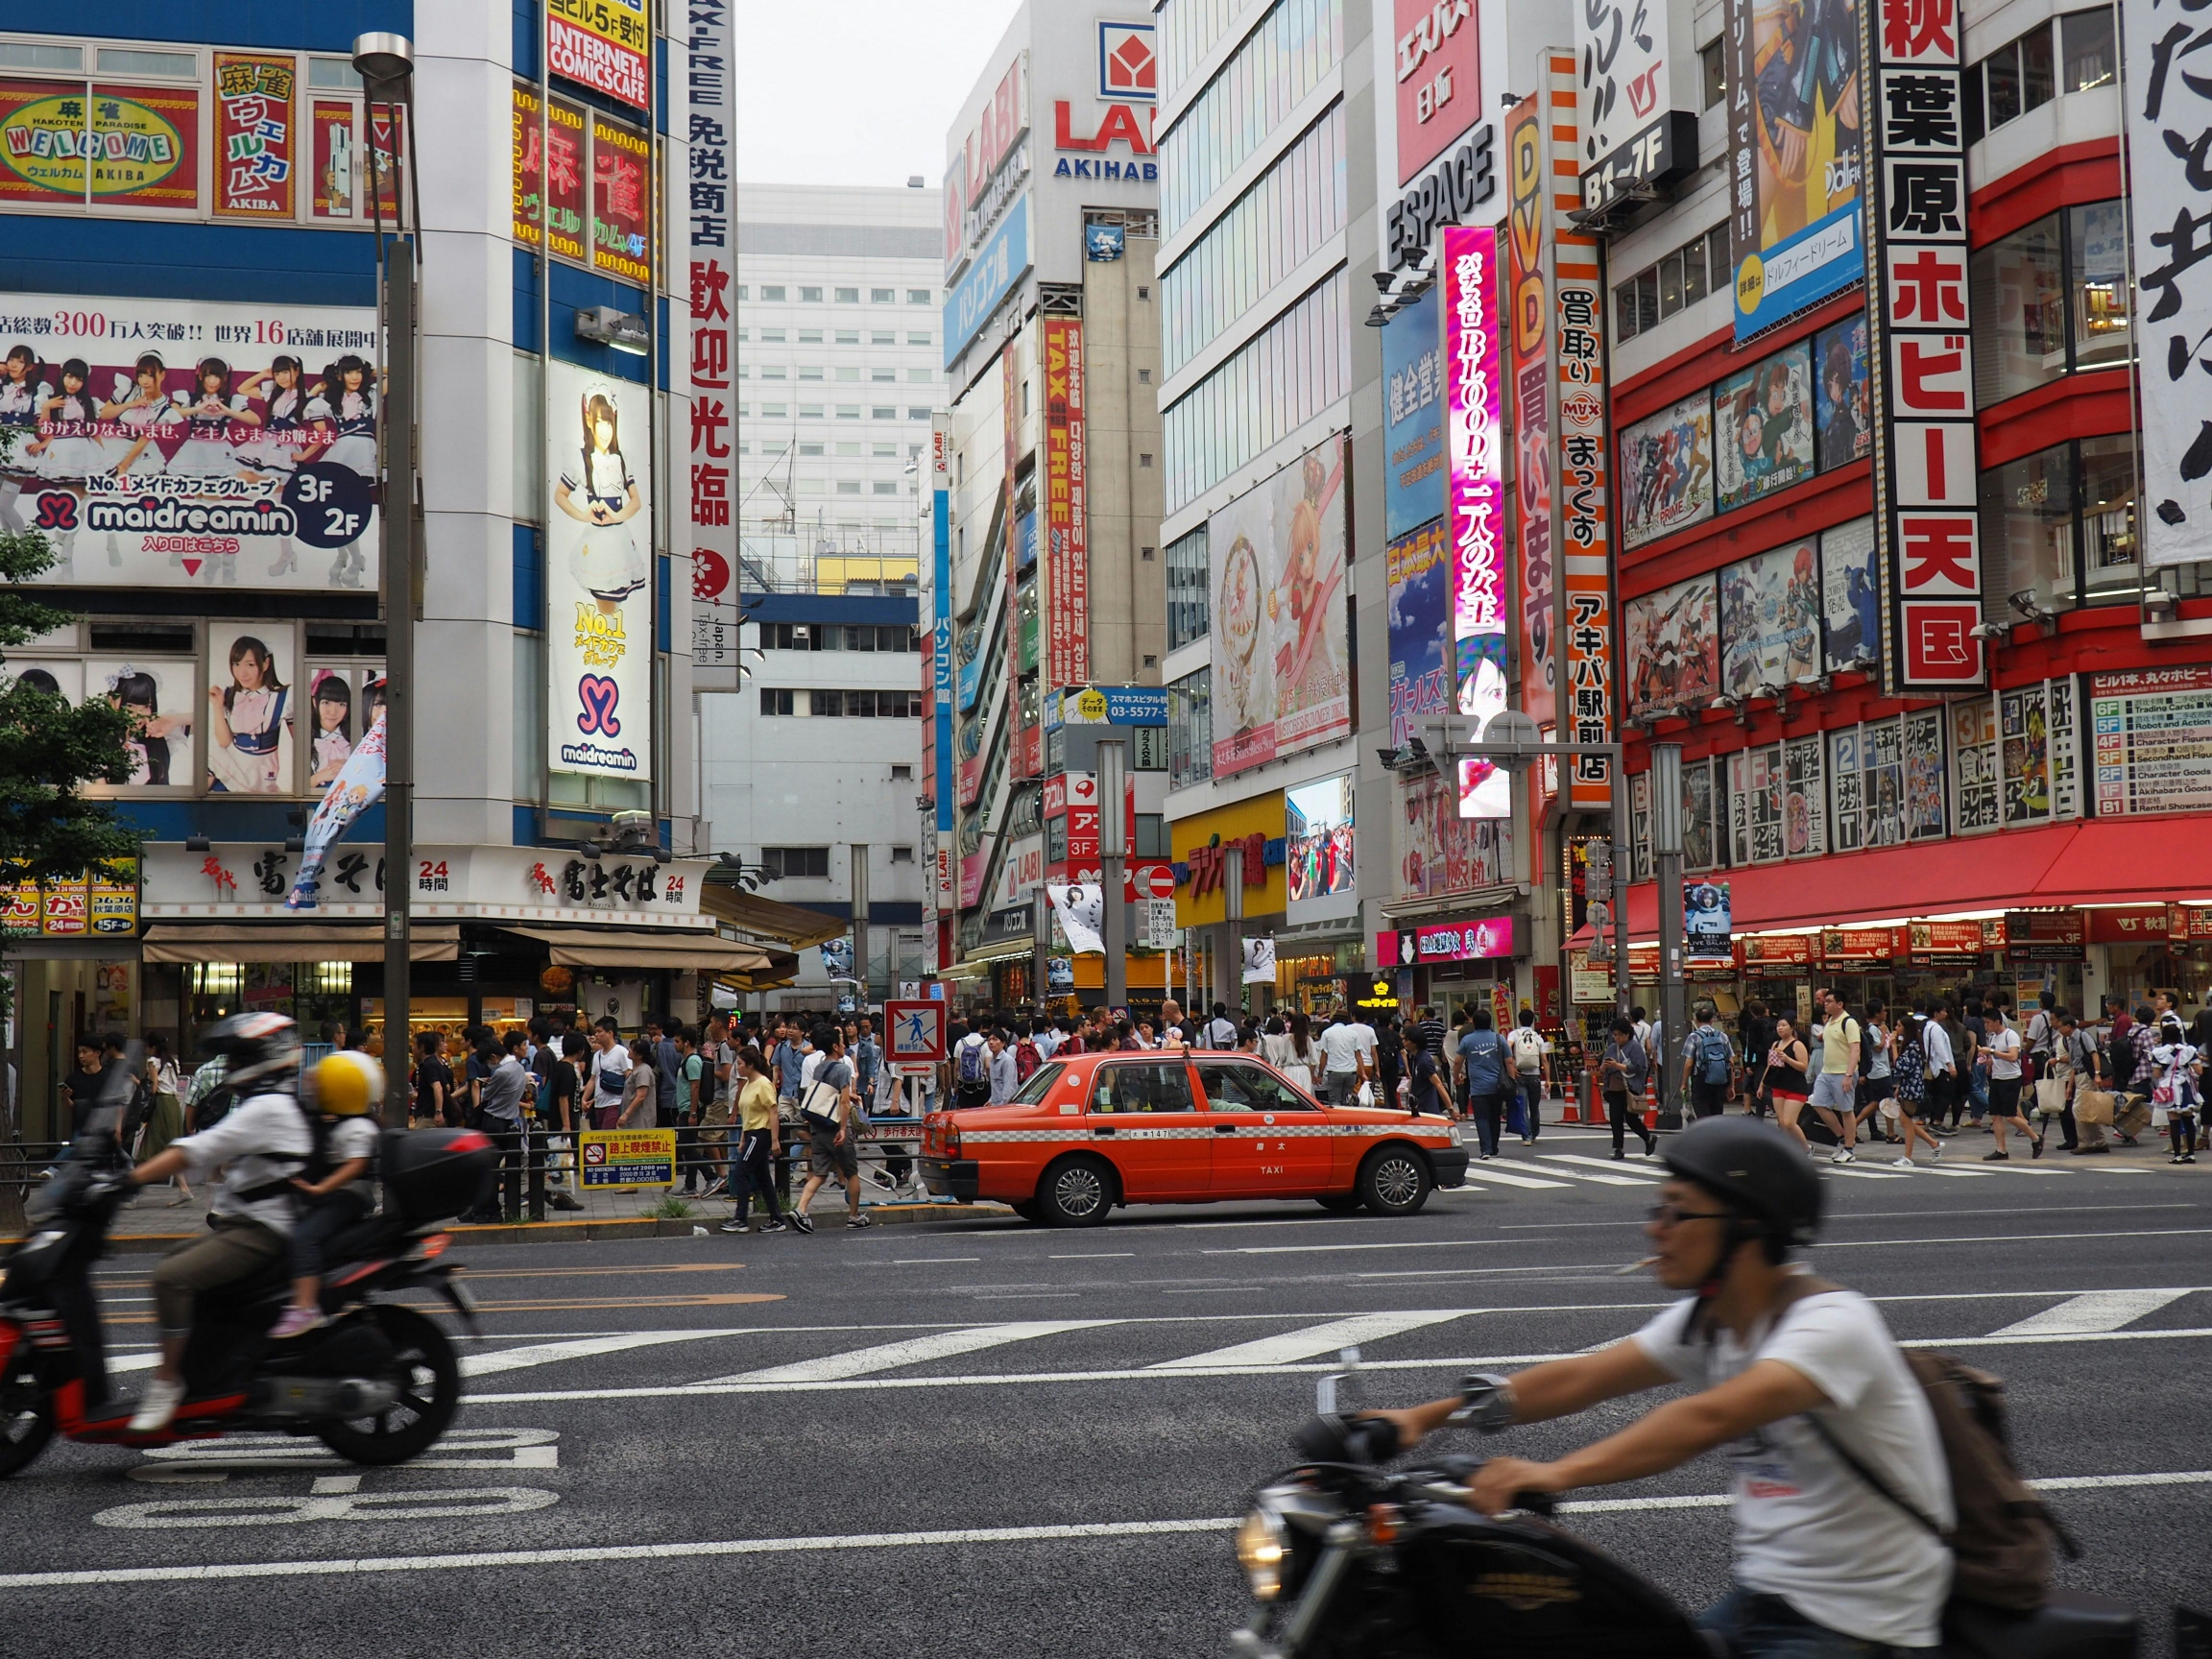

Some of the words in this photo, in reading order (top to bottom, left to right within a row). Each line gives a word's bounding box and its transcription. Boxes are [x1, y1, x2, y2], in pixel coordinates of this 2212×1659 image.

[219, 64, 291, 98] 麻雀
[33, 117, 84, 128] HAKOTEN
[95, 121, 148, 130] PARADISE
[966, 53, 1019, 211] LABI
[1055, 100, 1158, 155] LA
[8, 127, 170, 160] WELCOME
[228, 98, 290, 196] ウェルカム
[27, 166, 84, 180] ウェルカム
[96, 168, 145, 181] AKIBA
[228, 198, 280, 211] AKIBA
[1387, 124, 1495, 272] ESPACE
[1510, 116, 1547, 359] DVD
[1767, 229, 1847, 288] ドルフィードリーム
[1560, 289, 1598, 385] 買取り
[1049, 328, 1067, 398] TAX
[934, 432, 943, 459] LABI
[1050, 428, 1069, 522] FREE
[298, 474, 333, 502] 3F
[1567, 436, 1598, 547] まっくす
[92, 500, 291, 535] maidreamin
[1660, 500, 1683, 524] PRIME
[325, 508, 360, 536] 2F
[142, 537, 240, 553] 入り口はこちら
[575, 601, 626, 639] No.1
[574, 634, 626, 655] メイドカフェ
[699, 613, 709, 663] Tax-free
[935, 617, 950, 704] パソコン館
[1574, 597, 1604, 780] アキバ駅前店
[2097, 702, 2118, 715] 6F
[2135, 706, 2167, 714] Trading
[2169, 703, 2195, 711] Cards
[1959, 705, 1995, 744] 3F
[2098, 718, 2119, 733] 5F
[2136, 721, 2161, 730] Robot
[1142, 730, 1151, 766] ガラス交換
[2099, 734, 2119, 748] 4F
[2136, 737, 2180, 747] Character
[563, 744, 636, 770] maidreamin
[2099, 751, 2121, 764] 3F
[2137, 752, 2190, 763] Secondhand
[2054, 732, 2076, 813] 中古
[2100, 767, 2121, 781] 2F
[2138, 771, 2180, 780] Character
[2183, 768, 2211, 777] Goods
[1045, 782, 1064, 811] アコム
[2103, 783, 2121, 797] 1F
[2139, 785, 2183, 795] Akihabara
[2103, 801, 2120, 813] B1
[2139, 804, 2167, 812] Rental
[1071, 842, 1091, 854] 3F
[420, 861, 448, 878] 24
[1019, 850, 1041, 884] LABI
[419, 878, 448, 891] 時間
[565, 859, 661, 902] 富士そば
[666, 876, 685, 891] 24
[665, 891, 683, 904] 時間
[1964, 942, 1980, 951] 4F
[2065, 933, 2081, 944] 3F
[1793, 953, 1808, 962] 5F
[1875, 948, 1889, 957] 4F
[898, 1044, 925, 1052] 横断禁止
[610, 1141, 671, 1154] 路上喫煙禁止
